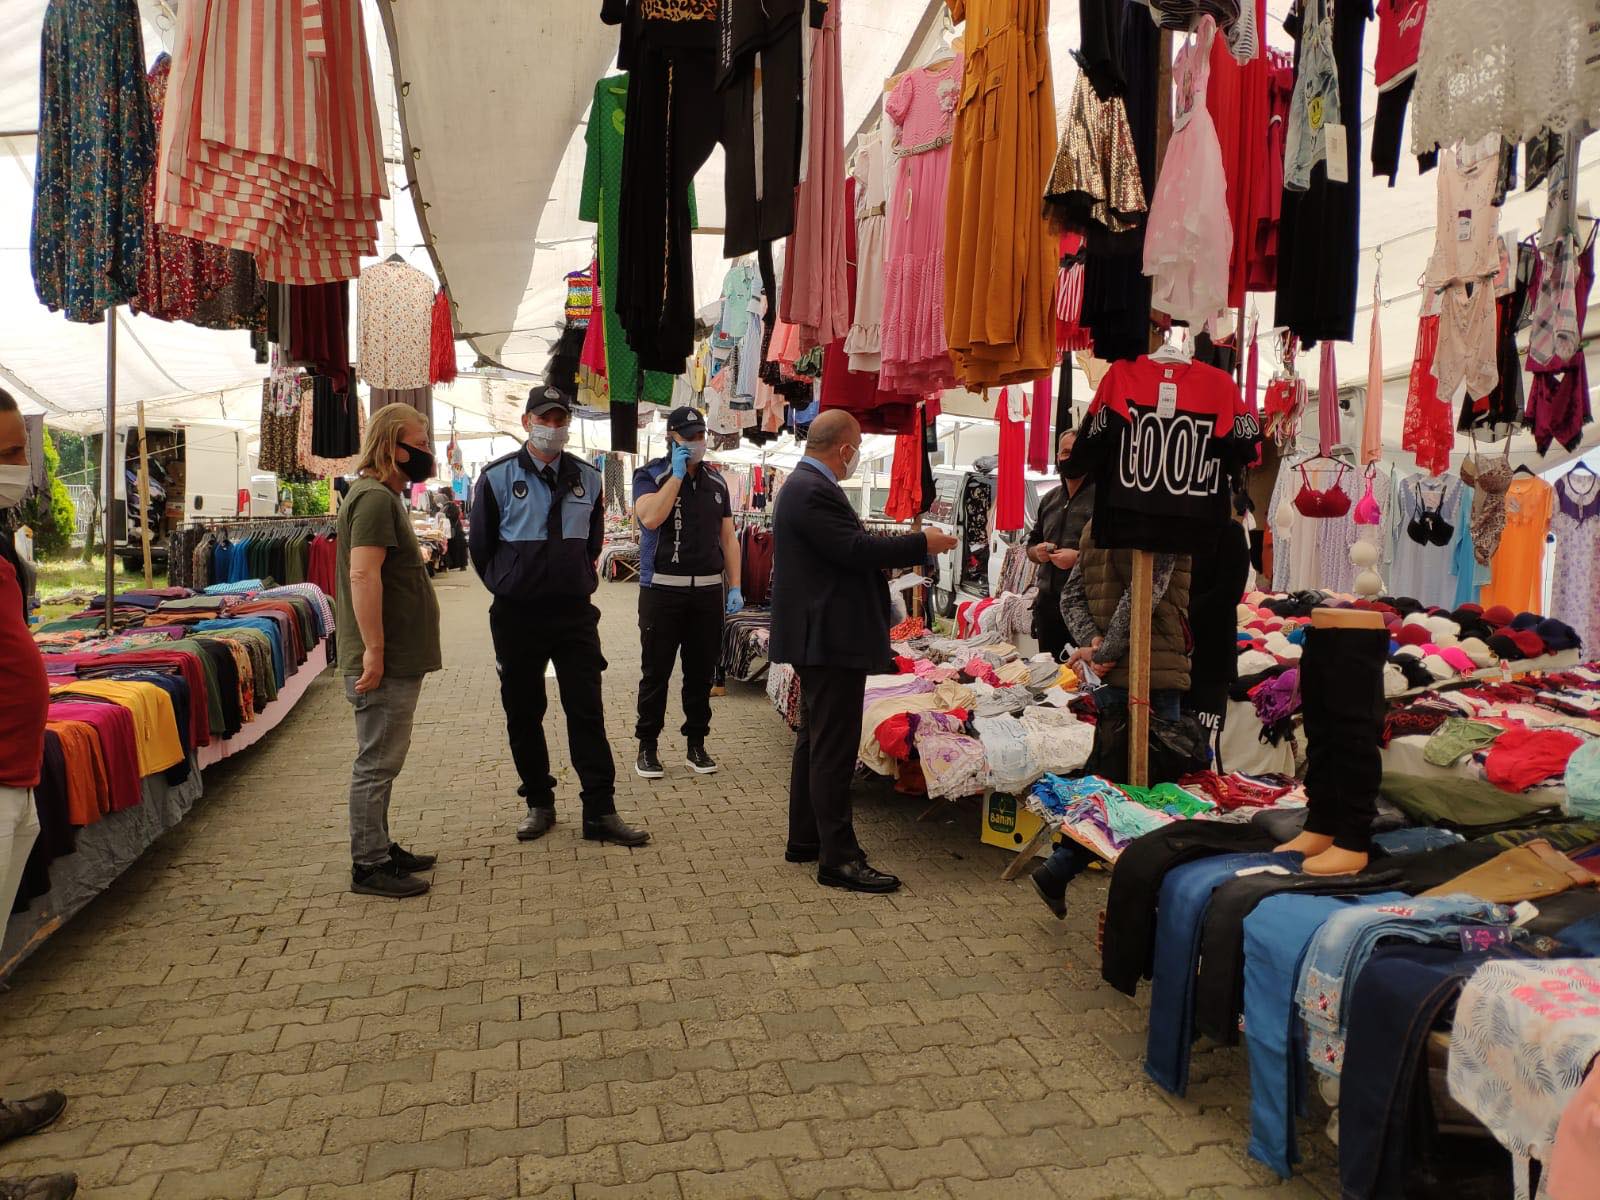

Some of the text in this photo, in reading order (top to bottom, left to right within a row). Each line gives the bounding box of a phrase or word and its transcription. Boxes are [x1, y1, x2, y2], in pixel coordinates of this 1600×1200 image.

[1119, 406, 1221, 497] COOL
[671, 496, 683, 564] ZABITA
[1193, 710, 1222, 730] OVE
